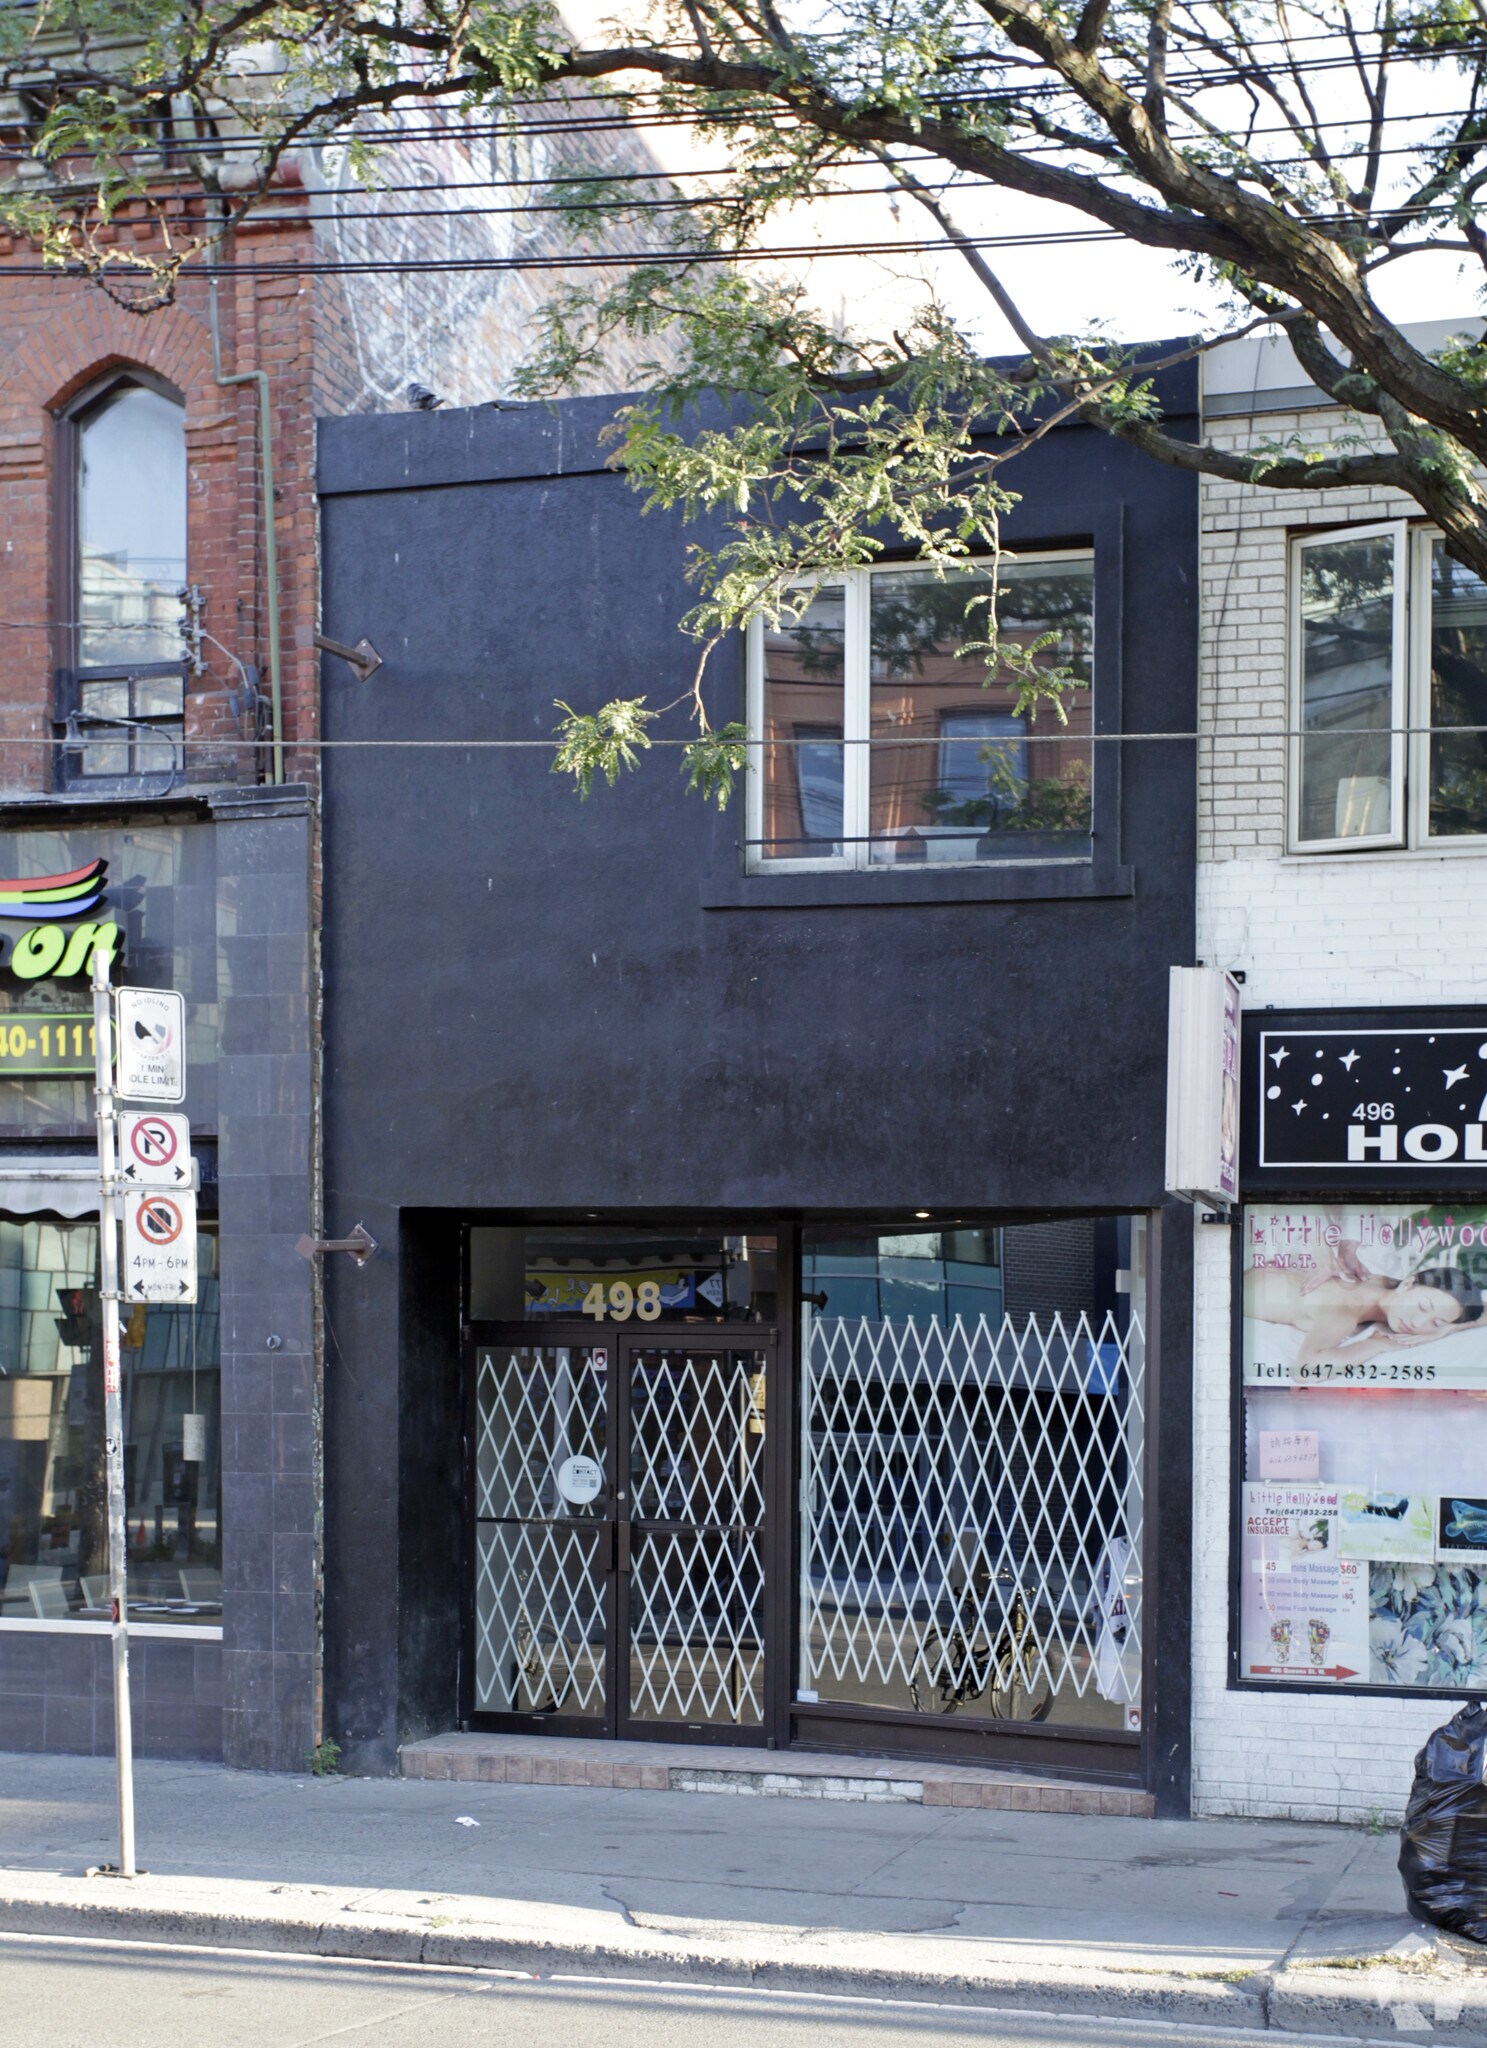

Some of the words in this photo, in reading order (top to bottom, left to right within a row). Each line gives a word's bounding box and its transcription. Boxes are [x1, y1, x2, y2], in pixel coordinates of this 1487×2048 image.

[131, 999, 142, 1009] NO
[144, 997, 170, 1012] IDLING
[148, 1064, 164, 1073] MIN
[129, 1074, 149, 1083] IDLE
[151, 1075, 175, 1086] LIMIT
[1352, 1102, 1395, 1121] 496
[1249, 1214, 1343, 1246] Little
[133, 1255, 155, 1268] 4PM
[166, 1256, 188, 1269] 6PM
[1253, 1253, 1317, 1268] R.M.T.
[582, 1280, 662, 1322] 498
[1253, 1362, 1290, 1378] Tel:
[1300, 1363, 1436, 1381] 647-832-2585
[1250, 1490, 1283, 1506] Little
[1286, 1491, 1338, 1506] Hollywood
[1247, 1517, 1289, 1526] ACCEPT
[1247, 1526, 1289, 1535] INSURANCE
[1266, 1562, 1276, 1571] 45
[1309, 1564, 1339, 1575] Massage
[1341, 1564, 1357, 1574] $60
